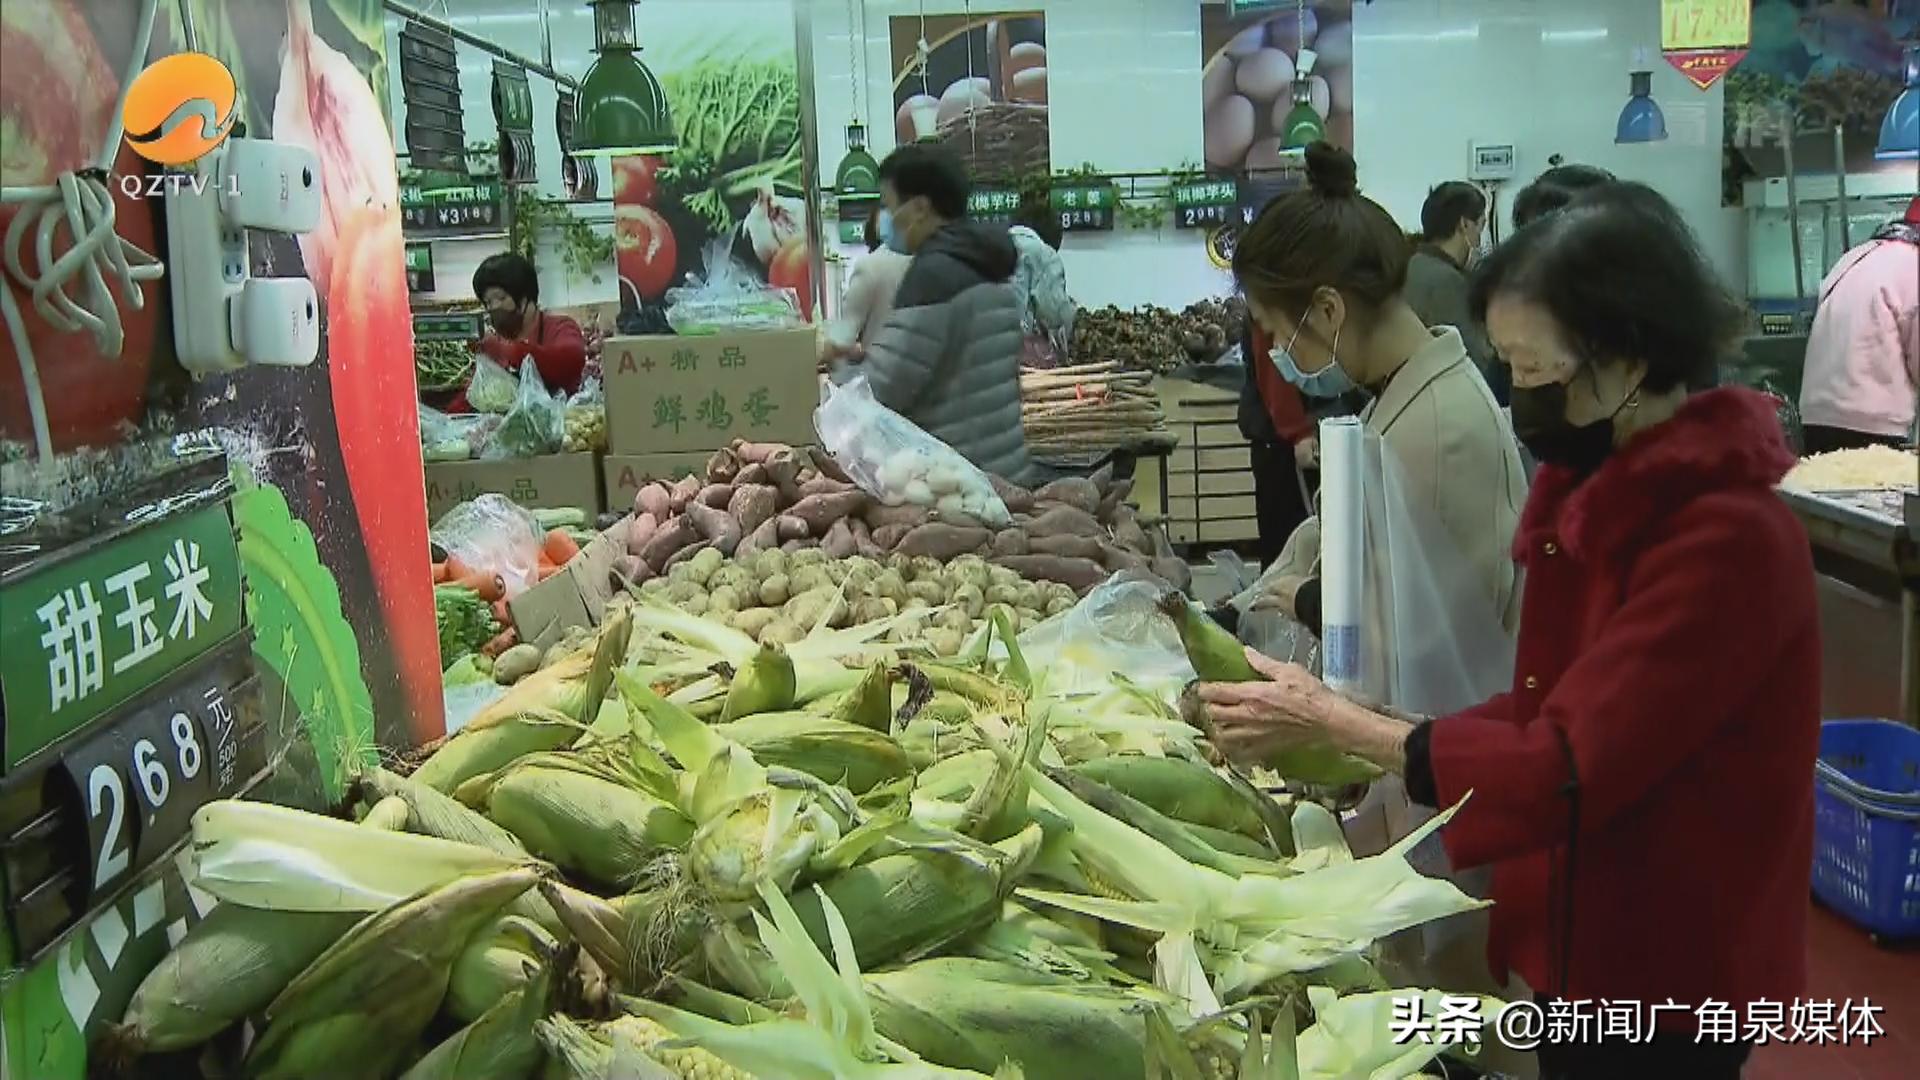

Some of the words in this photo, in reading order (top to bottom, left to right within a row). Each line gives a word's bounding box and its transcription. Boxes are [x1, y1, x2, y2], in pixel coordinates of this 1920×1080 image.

[652, 386, 779, 434] 鲜鸡蛋
[36, 538, 214, 713] 甜玉米
